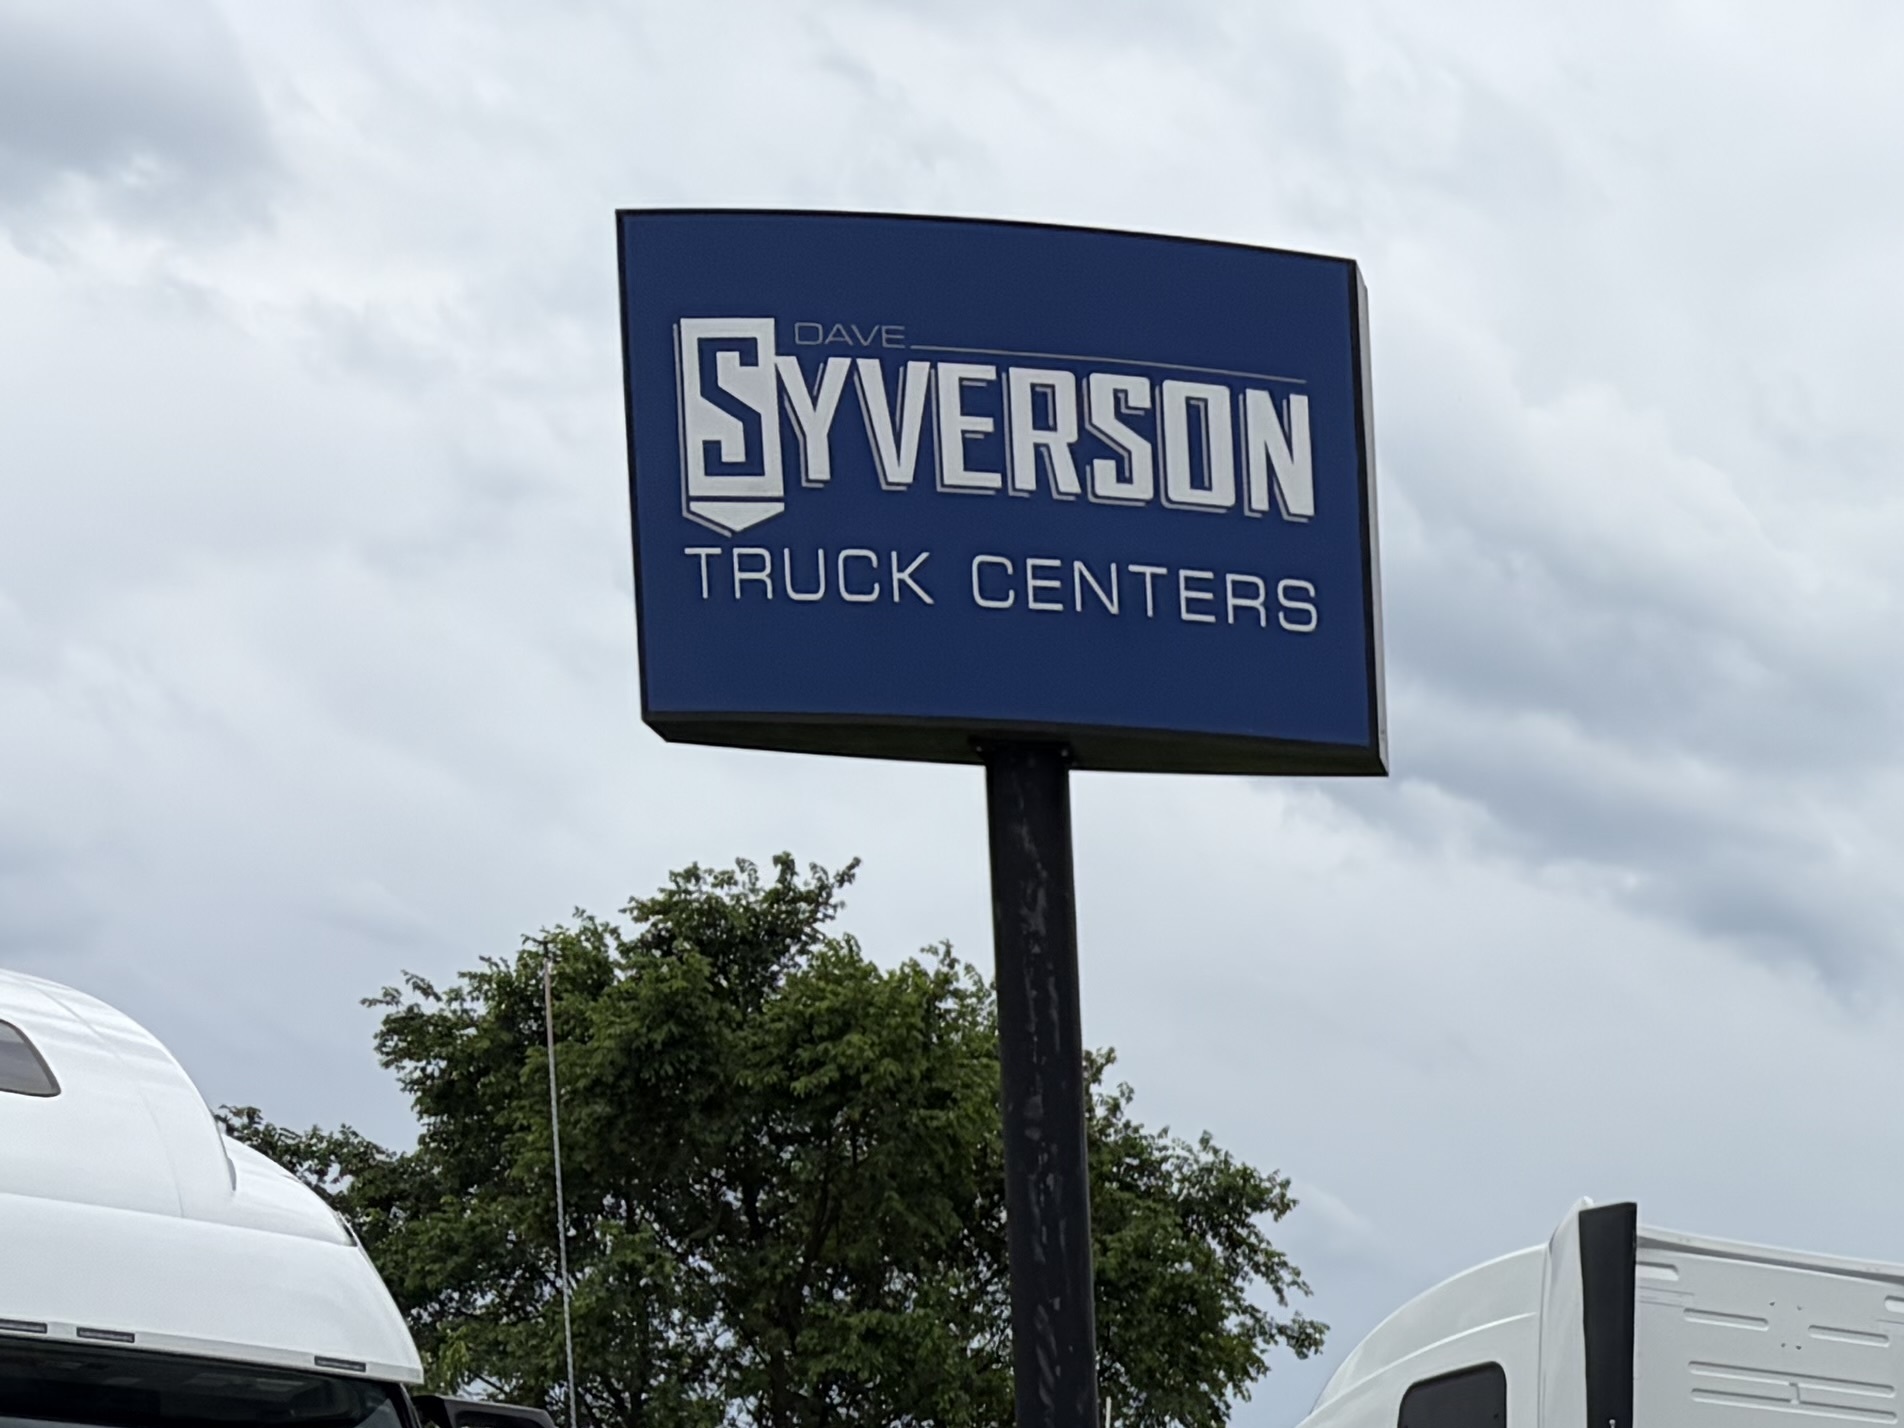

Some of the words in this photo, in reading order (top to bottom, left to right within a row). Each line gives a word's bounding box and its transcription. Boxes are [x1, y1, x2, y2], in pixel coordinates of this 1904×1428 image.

[793, 321, 906, 349] DAVE
[674, 317, 1315, 523] SYVERSON
[684, 546, 935, 606] TRUCK
[970, 553, 1318, 633] CENTERS
